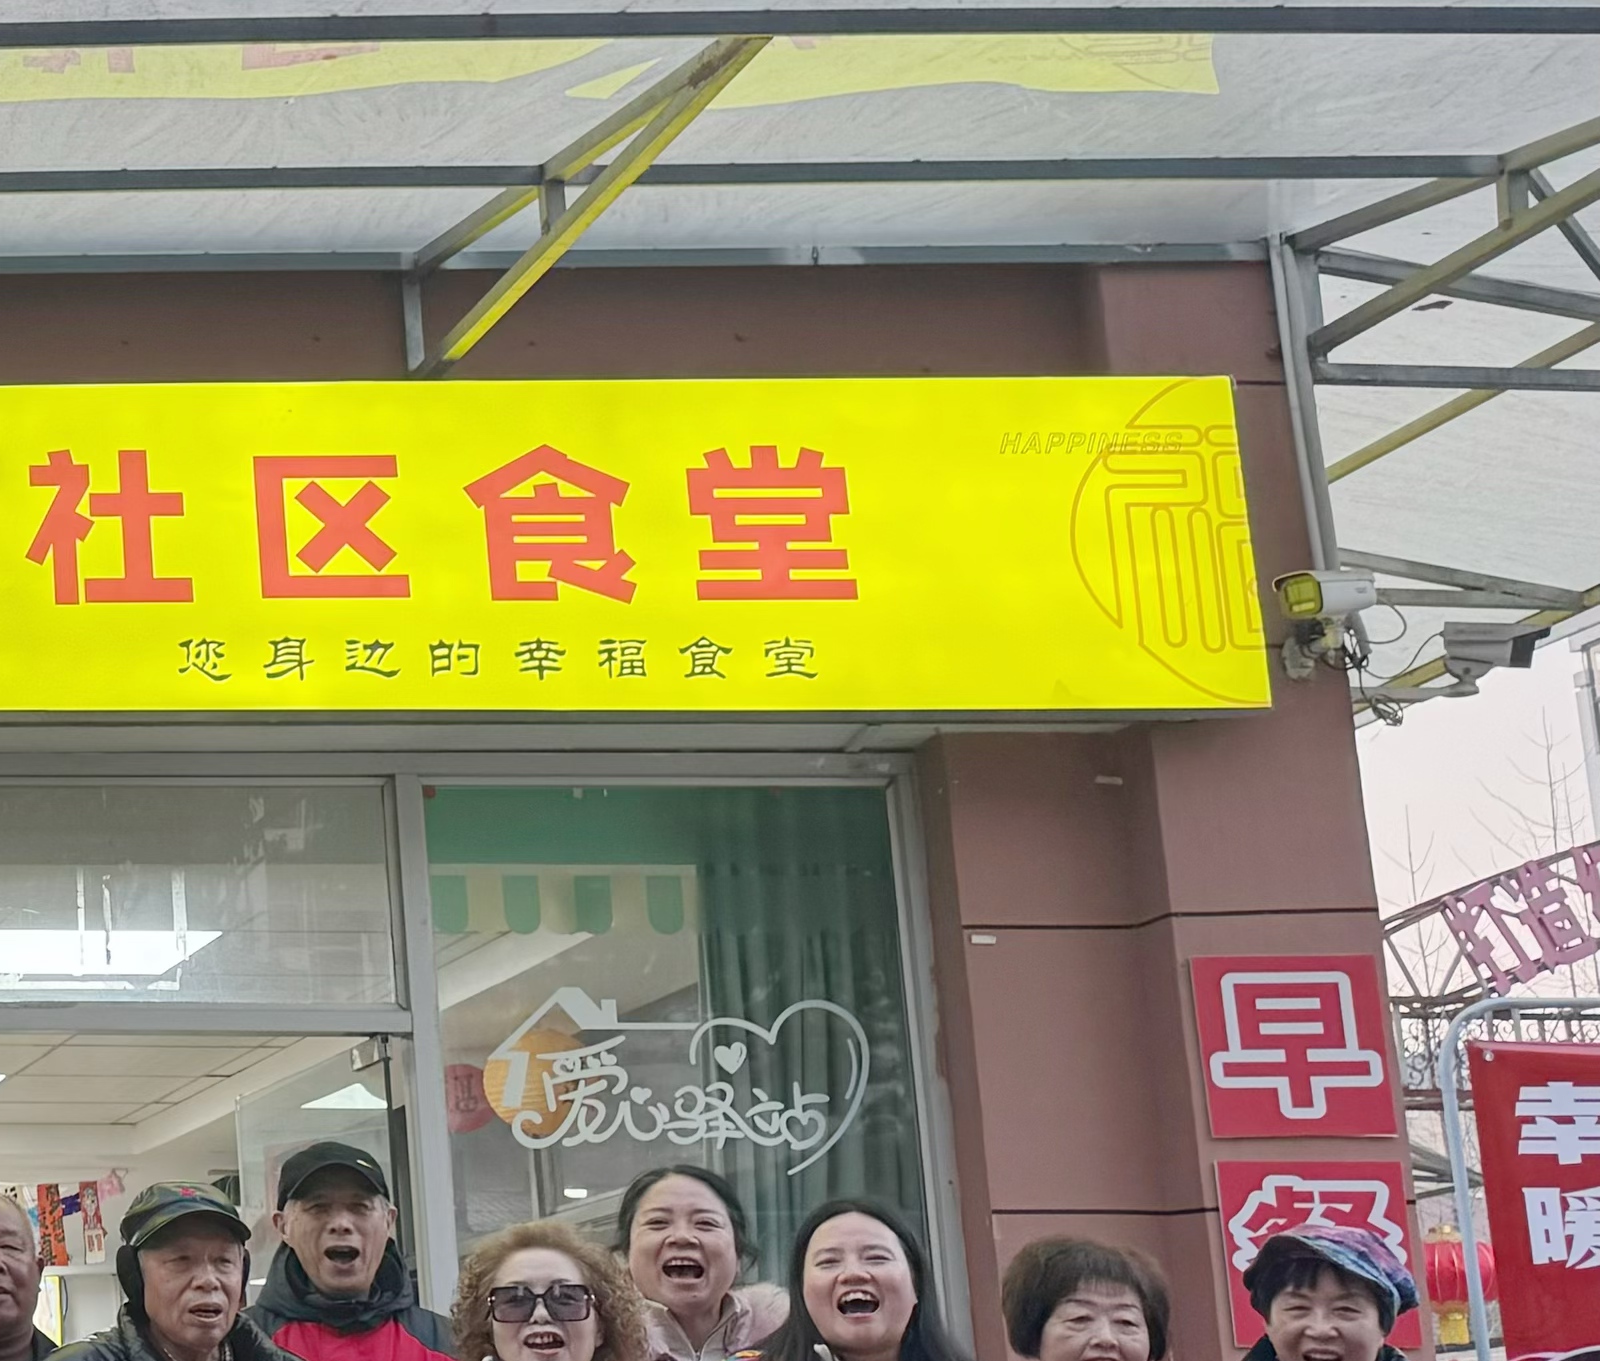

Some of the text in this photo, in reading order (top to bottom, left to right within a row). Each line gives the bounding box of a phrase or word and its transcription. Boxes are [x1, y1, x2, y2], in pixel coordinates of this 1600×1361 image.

[999, 431, 1184, 455] HAPPINESS
[176, 636, 820, 682] 您身边的幸福食堂
